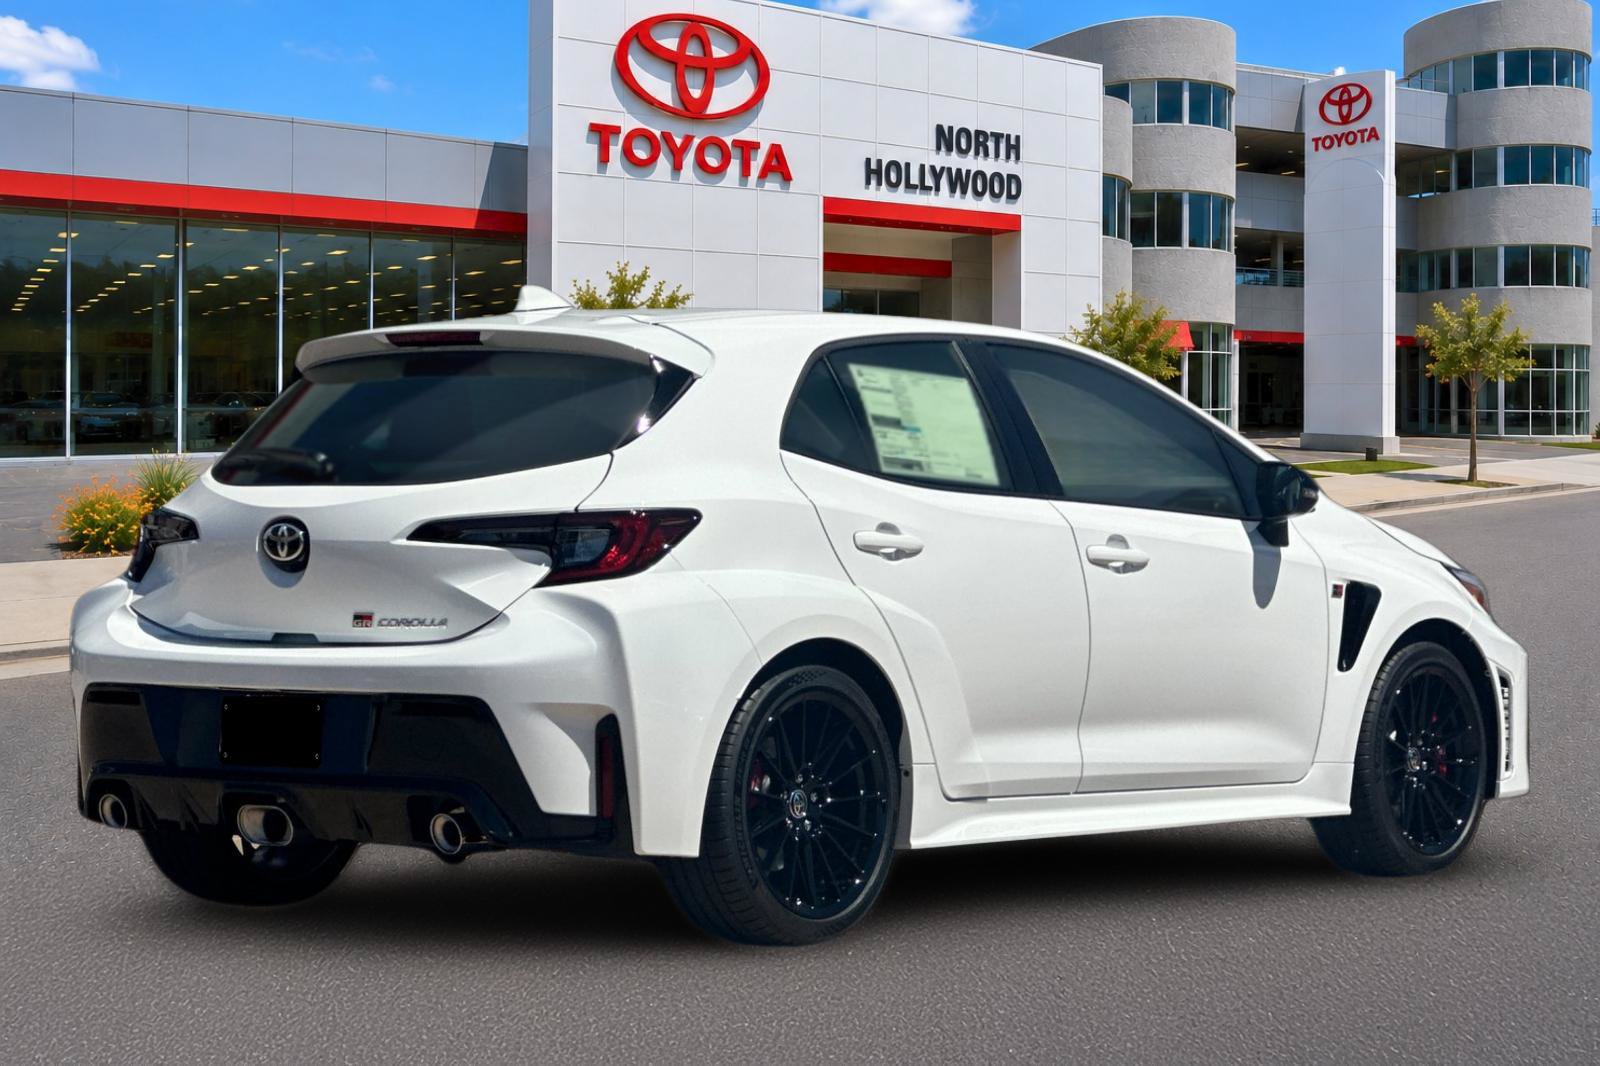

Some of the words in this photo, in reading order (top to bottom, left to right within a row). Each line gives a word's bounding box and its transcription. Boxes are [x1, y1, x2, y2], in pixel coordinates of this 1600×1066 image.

[589, 122, 793, 182] TOYOTA
[936, 124, 1021, 161] NORTH
[1312, 126, 1379, 152] TOYOTA
[865, 157, 1021, 201] HOLLYWOOD
[377, 618, 448, 627] COROLLA
